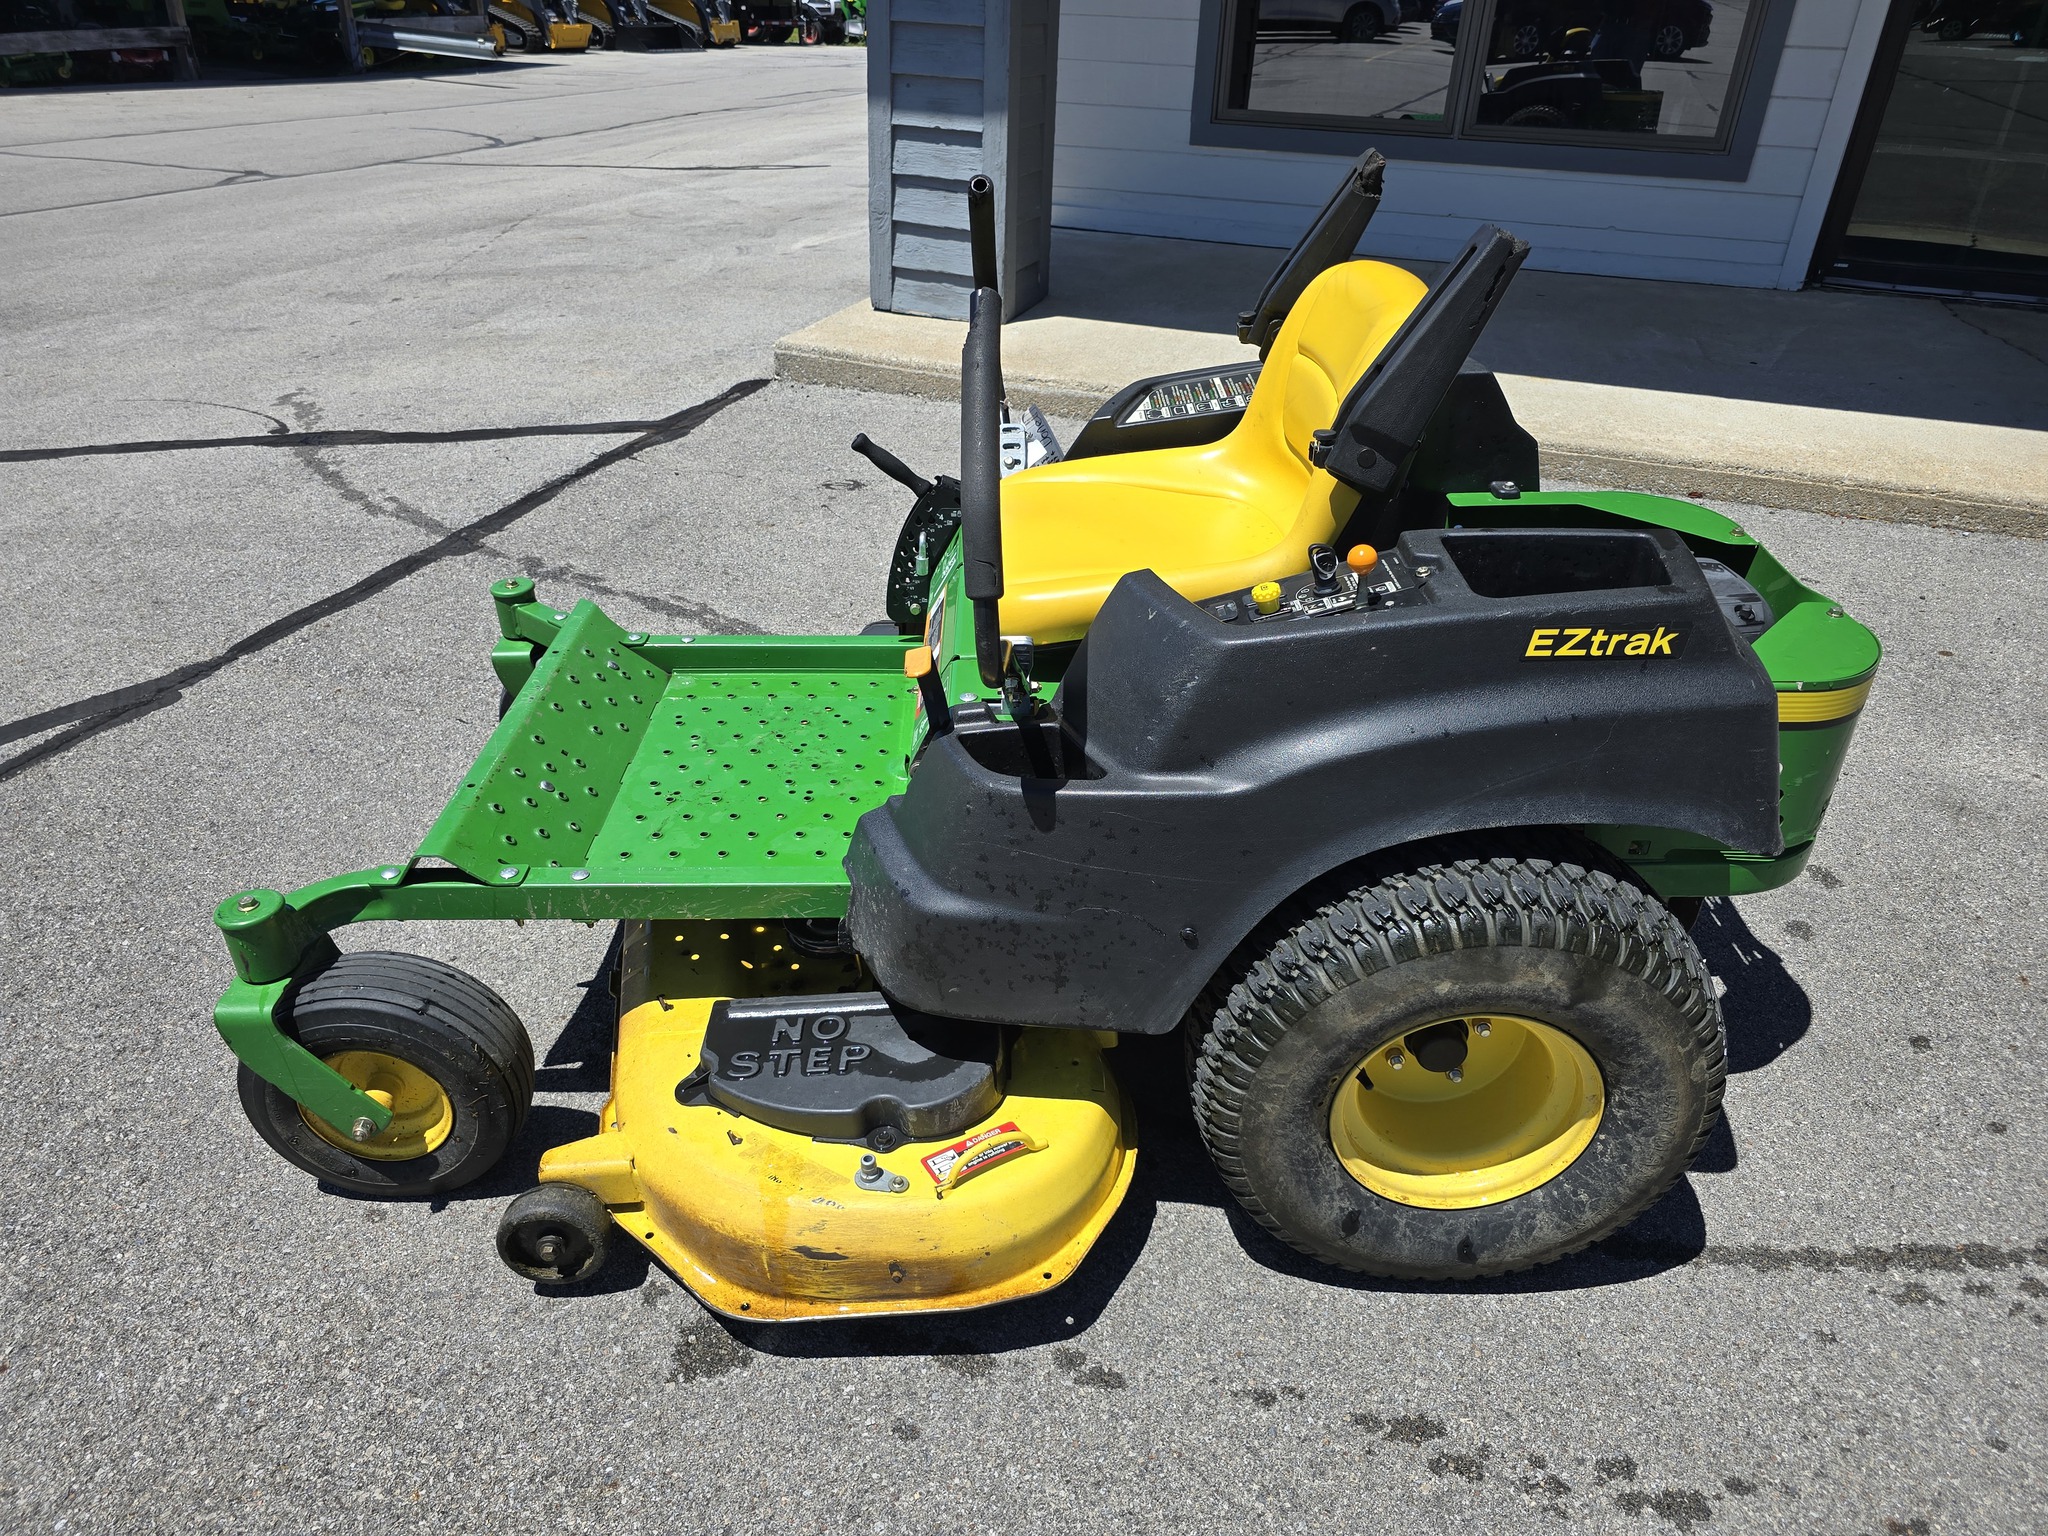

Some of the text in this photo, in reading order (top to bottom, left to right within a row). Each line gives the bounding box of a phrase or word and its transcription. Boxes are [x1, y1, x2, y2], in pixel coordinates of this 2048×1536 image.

[1525, 627, 1679, 657] EZtrak
[771, 1015, 846, 1044] NO
[727, 1045, 871, 1078] STEP
[973, 1129, 1001, 1143] DANGER
[987, 1147, 1005, 1158] running
